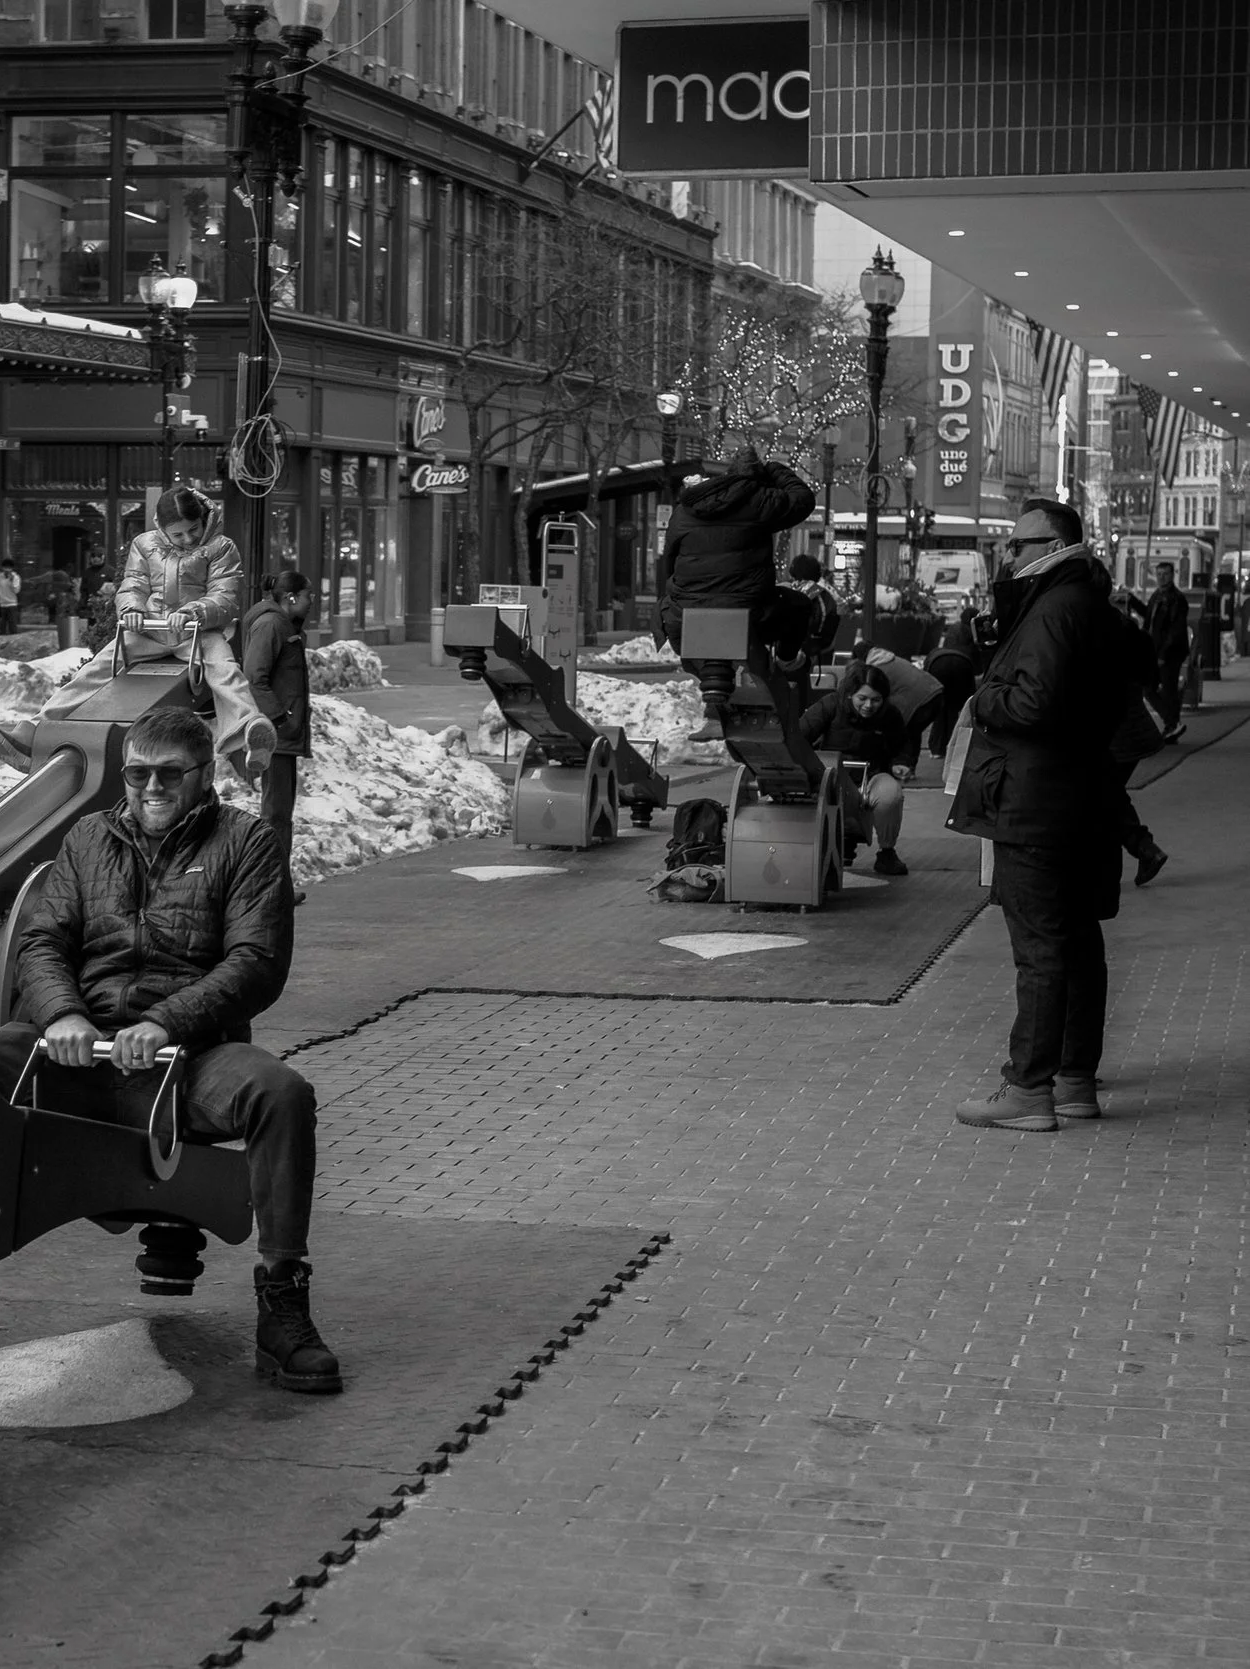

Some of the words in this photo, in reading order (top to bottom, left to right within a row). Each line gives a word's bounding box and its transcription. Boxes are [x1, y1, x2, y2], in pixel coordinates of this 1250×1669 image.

[939, 450, 968, 460] uno
[411, 464, 470, 492] Cane's
[944, 473, 963, 487] go
